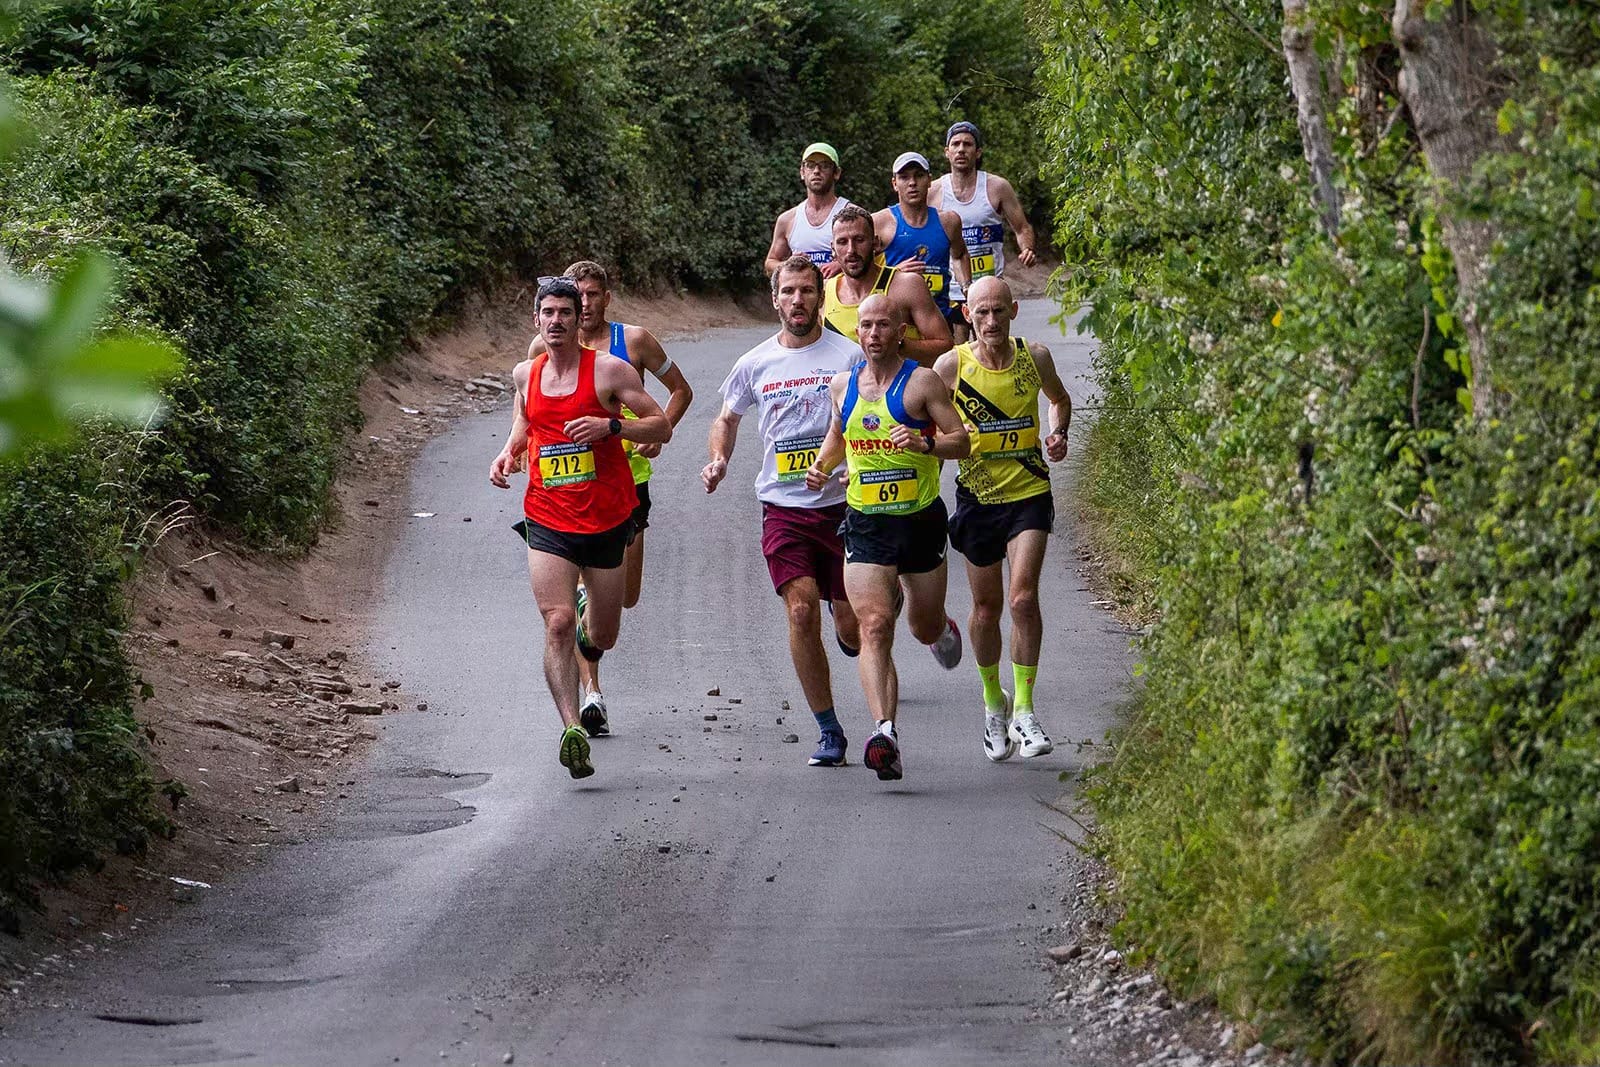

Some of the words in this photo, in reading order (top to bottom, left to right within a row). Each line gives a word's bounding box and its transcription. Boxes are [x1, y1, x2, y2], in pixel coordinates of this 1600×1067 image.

[784, 376, 820, 389] NEWPORT
[822, 376, 833, 384] 10
[999, 431, 1019, 450] 79
[551, 455, 582, 476] 212
[787, 450, 817, 472] 220
[879, 482, 899, 502] 69
